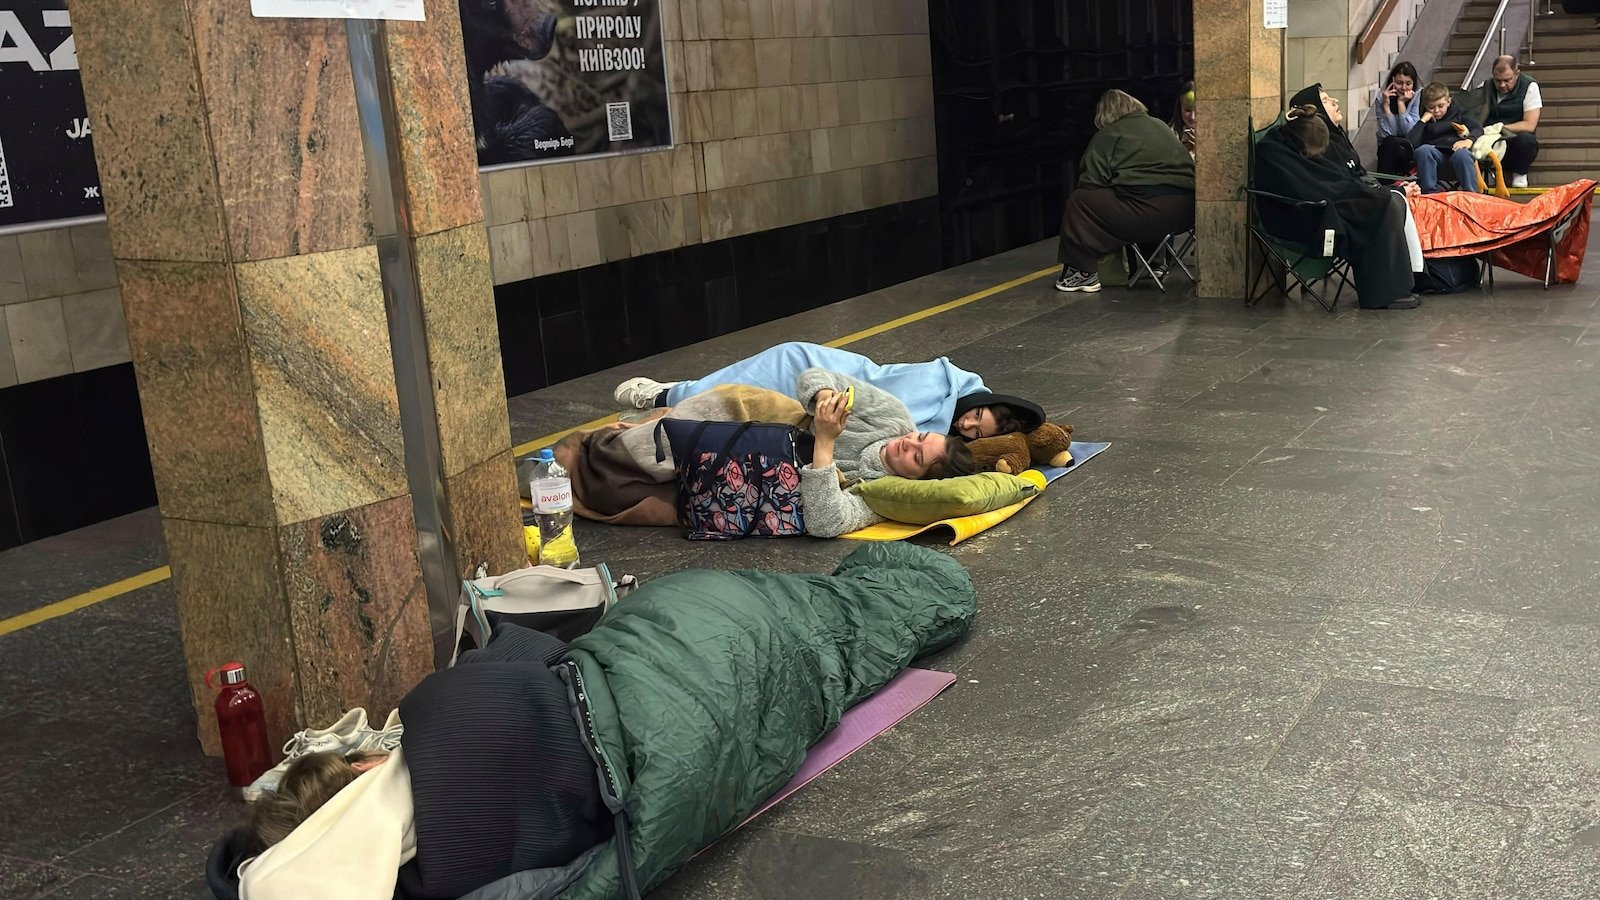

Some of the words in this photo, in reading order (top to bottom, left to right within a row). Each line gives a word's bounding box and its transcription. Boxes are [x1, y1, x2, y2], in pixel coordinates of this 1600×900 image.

[576, 15, 641, 39] ПРИРОДУ
[579, 43, 645, 72] КИЇВЗОО!
[541, 492, 570, 503] avalon
